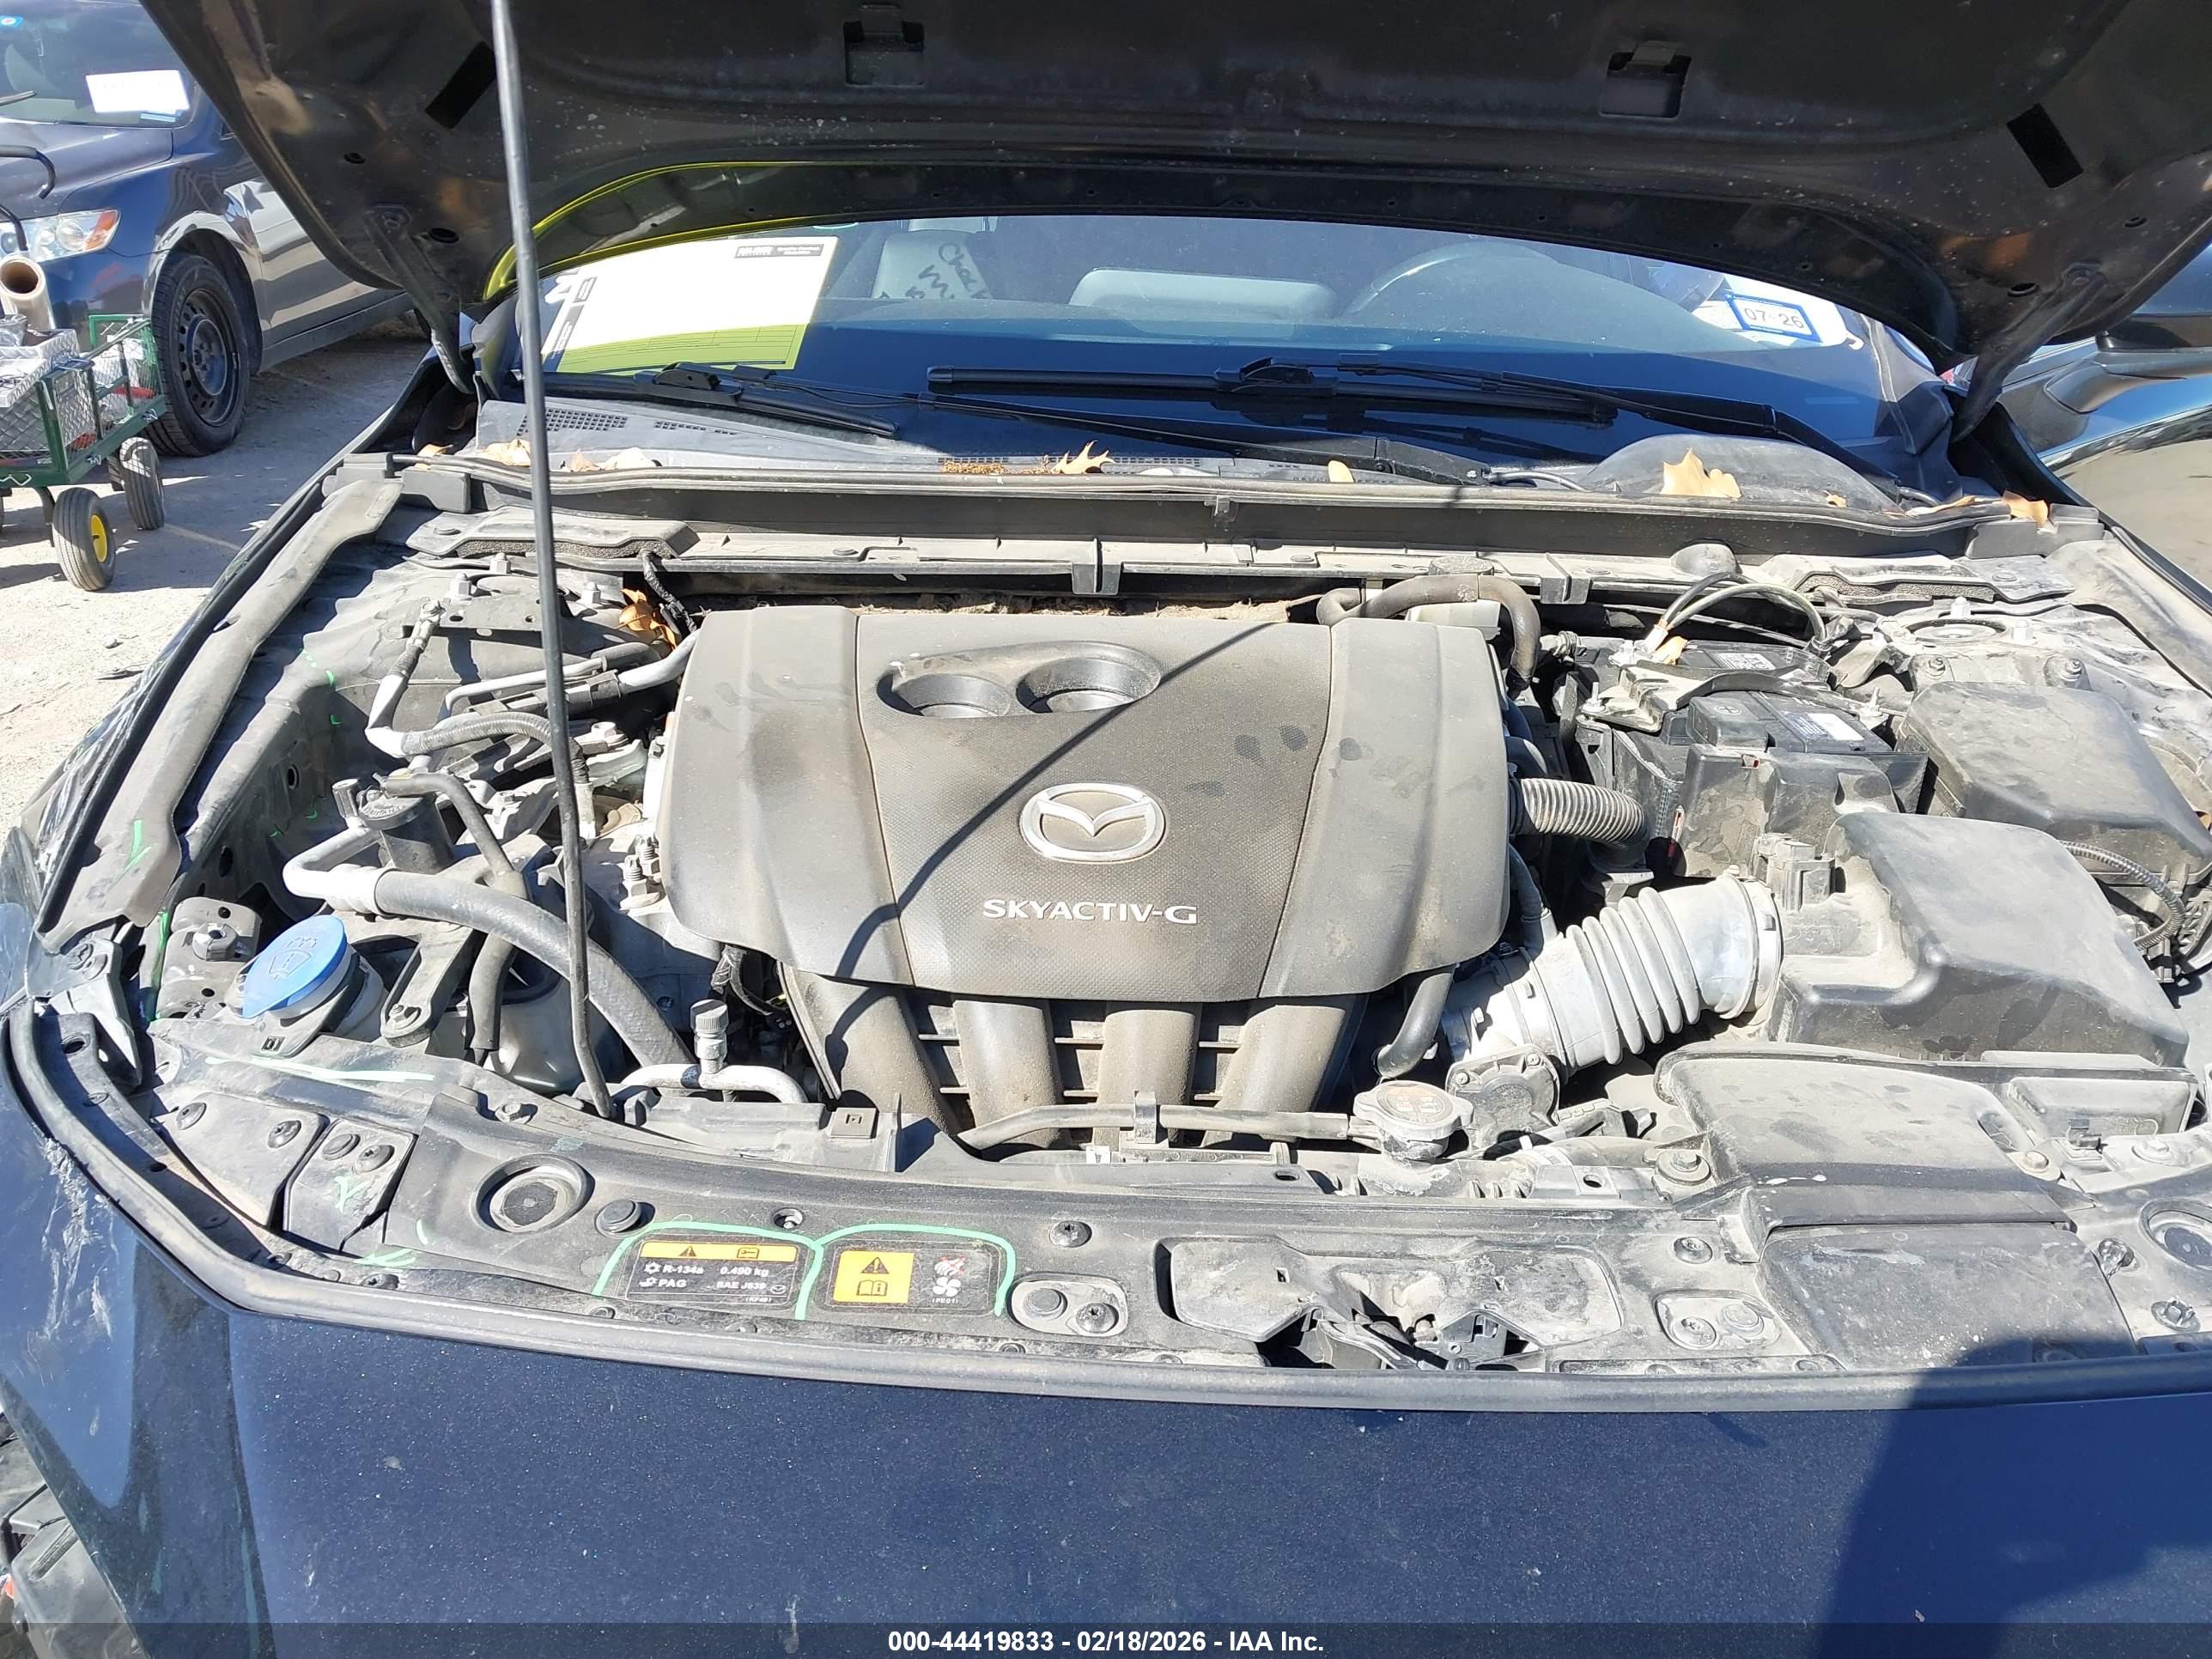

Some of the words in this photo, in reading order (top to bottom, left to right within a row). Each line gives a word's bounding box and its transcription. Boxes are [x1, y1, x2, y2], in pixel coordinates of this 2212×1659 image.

[982, 899, 1198, 925] SKYACTIV-G
[662, 1264, 704, 1274] R-134a
[753, 1267, 769, 1278] kg
[658, 1279, 688, 1288] PAG
